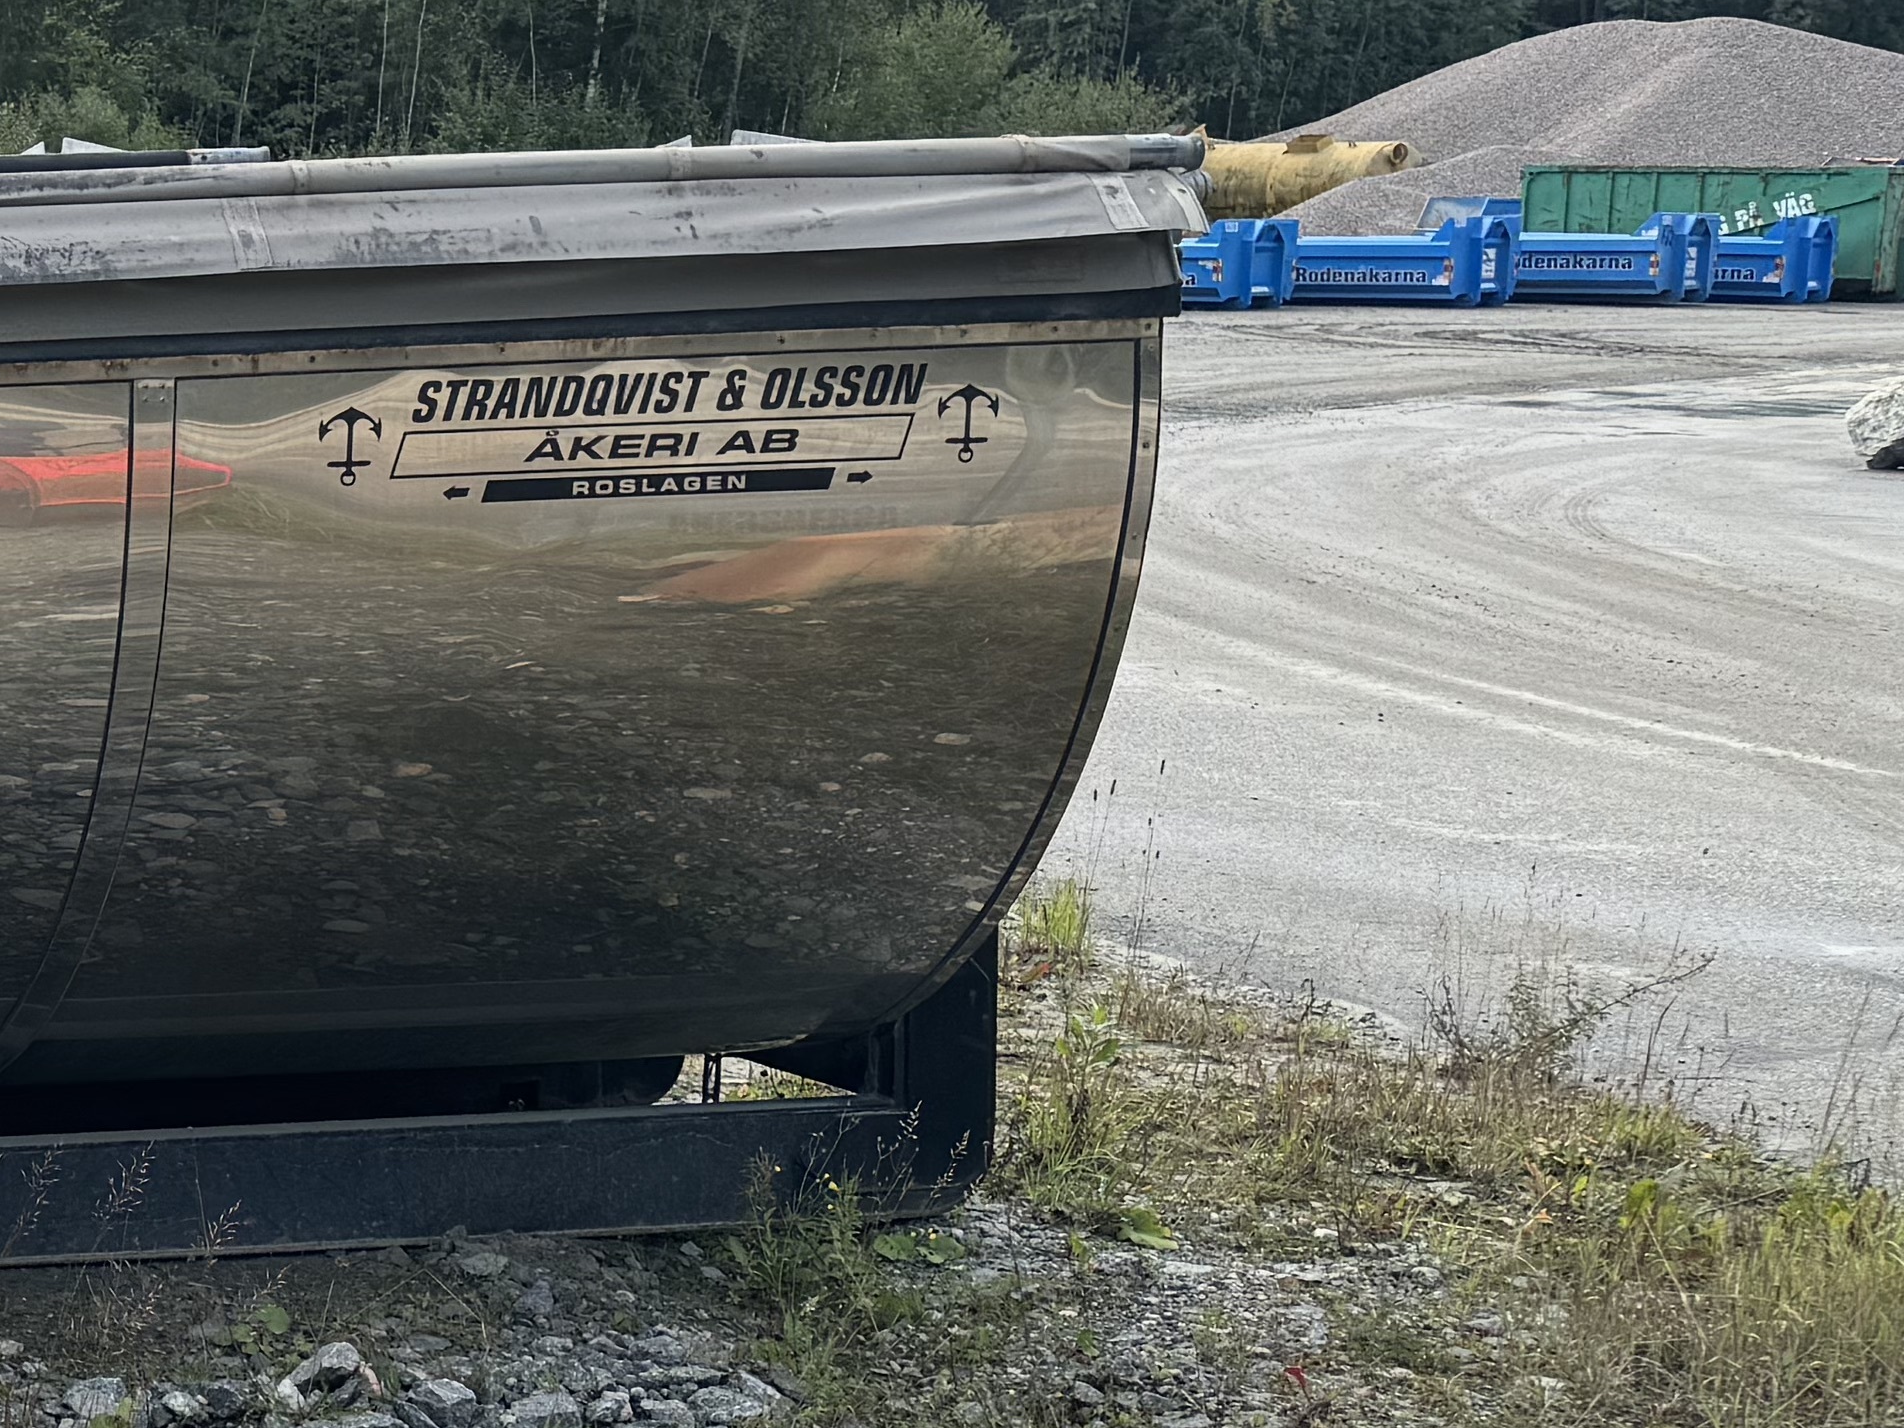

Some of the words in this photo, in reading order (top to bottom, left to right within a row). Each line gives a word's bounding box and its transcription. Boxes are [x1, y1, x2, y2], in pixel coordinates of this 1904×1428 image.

[412, 370, 709, 423] STRANDQVIST
[716, 369, 747, 412] &
[760, 363, 928, 410] OLSSON
[523, 430, 699, 462] ÅKERI
[716, 429, 799, 455] AB
[572, 475, 746, 496] ROSLAGEN
